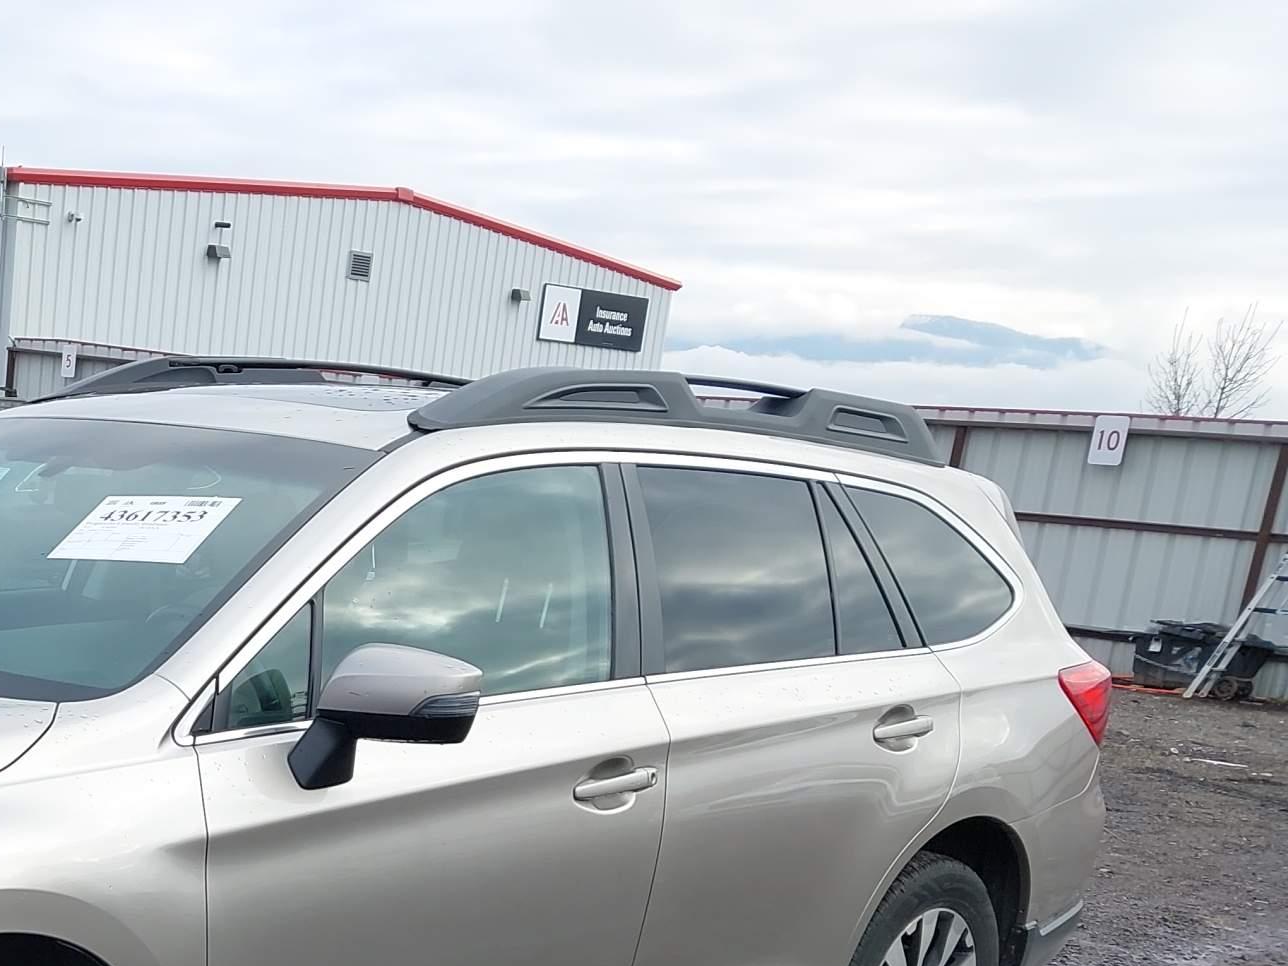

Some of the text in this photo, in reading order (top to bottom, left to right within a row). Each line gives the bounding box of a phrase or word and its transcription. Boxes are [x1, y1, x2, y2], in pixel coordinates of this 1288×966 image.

[595, 306, 629, 322] Insurance
[587, 319, 633, 337] Auto Auctions
[65, 354, 72, 369] 5
[1097, 430, 1121, 451] 10
[99, 509, 209, 523] 43617353
